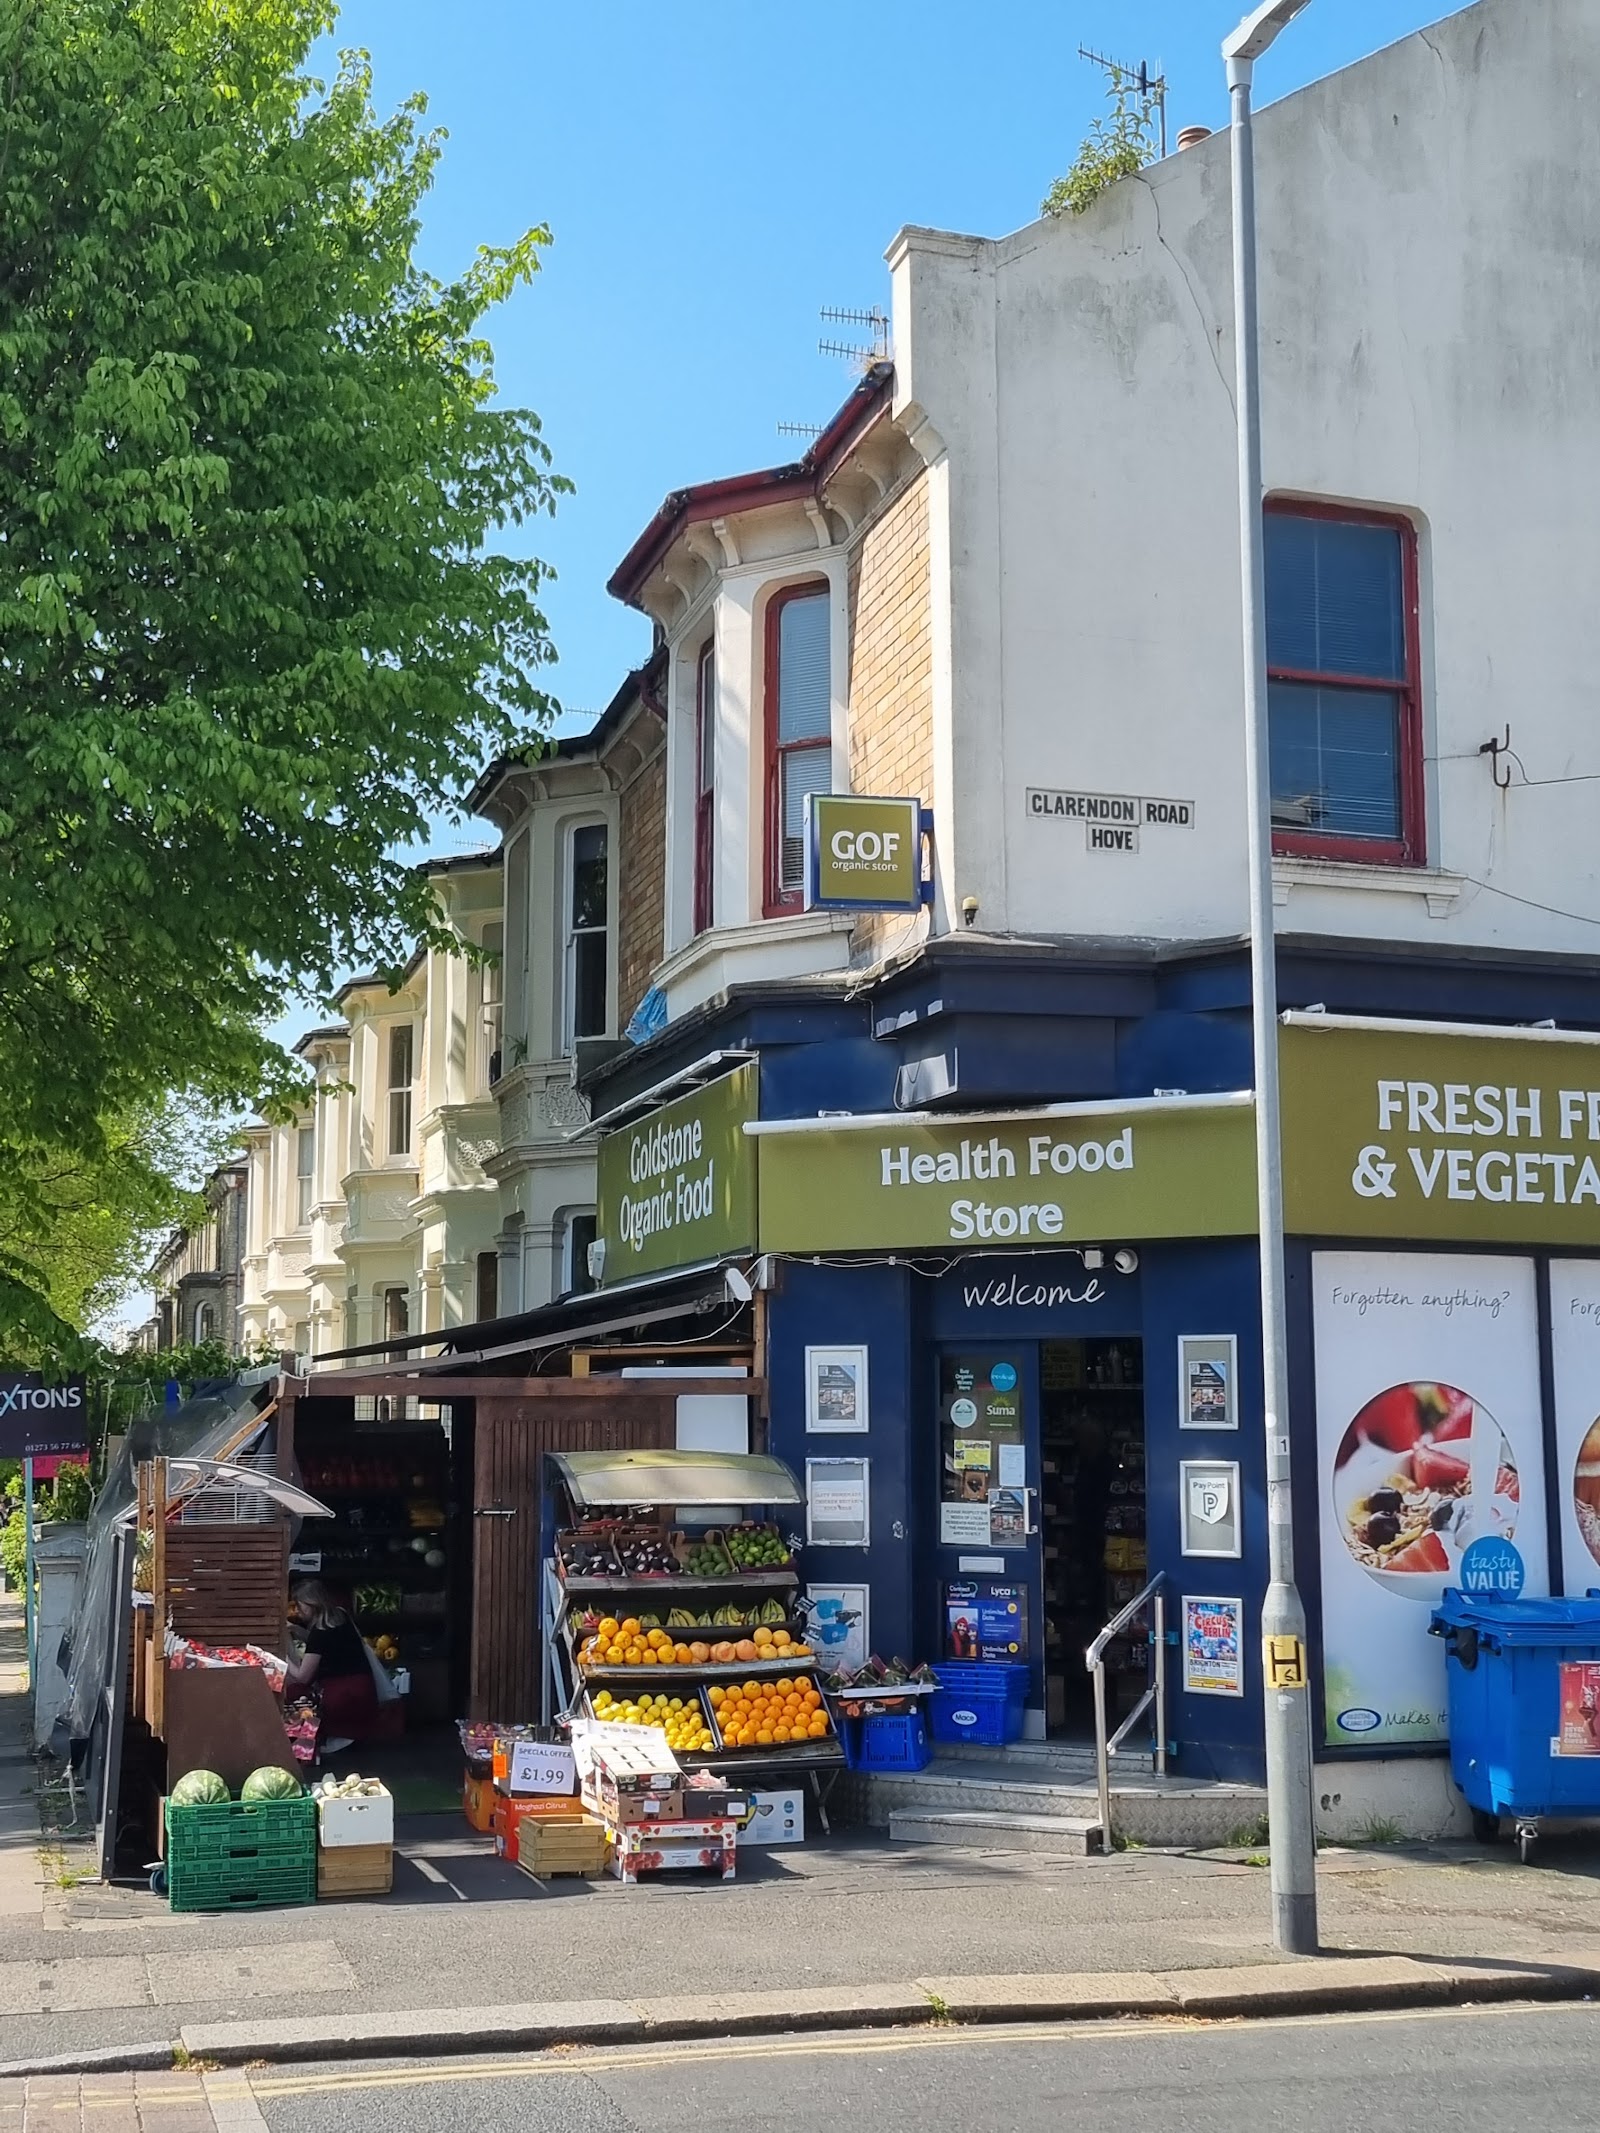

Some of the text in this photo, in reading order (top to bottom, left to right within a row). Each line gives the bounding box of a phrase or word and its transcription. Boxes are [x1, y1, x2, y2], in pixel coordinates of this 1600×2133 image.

[1032, 794, 1189, 825] CLARENDON ROAD
[831, 830, 900, 861] GOF
[1092, 828, 1133, 850] HOVE
[832, 860, 898, 872] organic store
[1377, 1080, 1542, 1137] FRESH
[630, 1119, 702, 1184] Goldstone
[881, 1127, 1134, 1186] Health Food
[1352, 1145, 1600, 1205] & VEGETA
[620, 1158, 714, 1252] Organic Food
[950, 1200, 1063, 1239] Store
[963, 1274, 1106, 1308] welcome
[1332, 1286, 1510, 1319] Forgotten anything?
[0, 1383, 82, 1417] XTONS
[986, 1405, 1016, 1416] Suma
[1280, 1438, 1287, 1453] 1
[1469, 1550, 1516, 1573] tasty
[1466, 1570, 1520, 1590] VALUE
[990, 1586, 1011, 1597] Lyca
[982, 1608, 1006, 1616] Unlimited
[1194, 1615, 1228, 1629] CIRCUS
[1203, 1627, 1231, 1638] BERLIN
[982, 1645, 1007, 1654] Unlimited
[1270, 1640, 1302, 1682] H
[955, 1713, 975, 1722] Mace
[1384, 1710, 1431, 1727] Makes
[518, 1746, 572, 1759] SPECIAL OFFER
[520, 1767, 565, 1784] £1.99
[514, 1803, 545, 1812] Moghazi
[545, 1801, 568, 1810] Citrus
